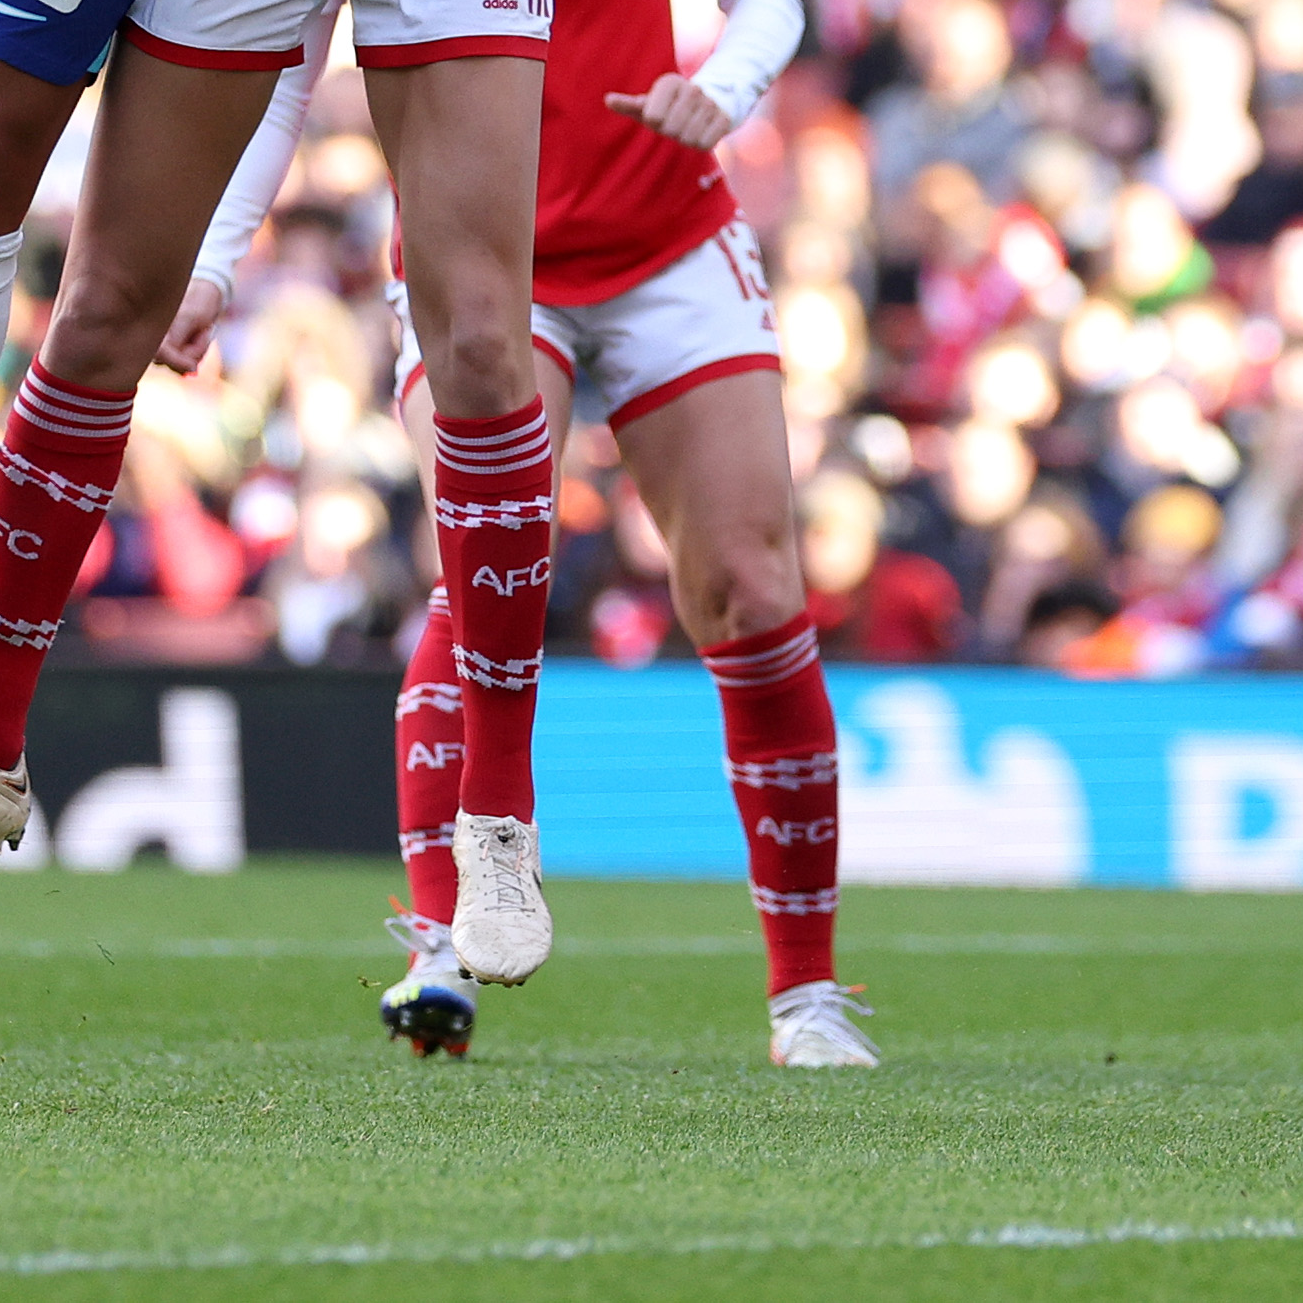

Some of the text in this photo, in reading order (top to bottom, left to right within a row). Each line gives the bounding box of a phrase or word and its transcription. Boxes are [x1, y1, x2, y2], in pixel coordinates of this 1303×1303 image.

[471, 556, 550, 597] AFC
[406, 740, 467, 771] AF
[755, 815, 837, 846] AFC
